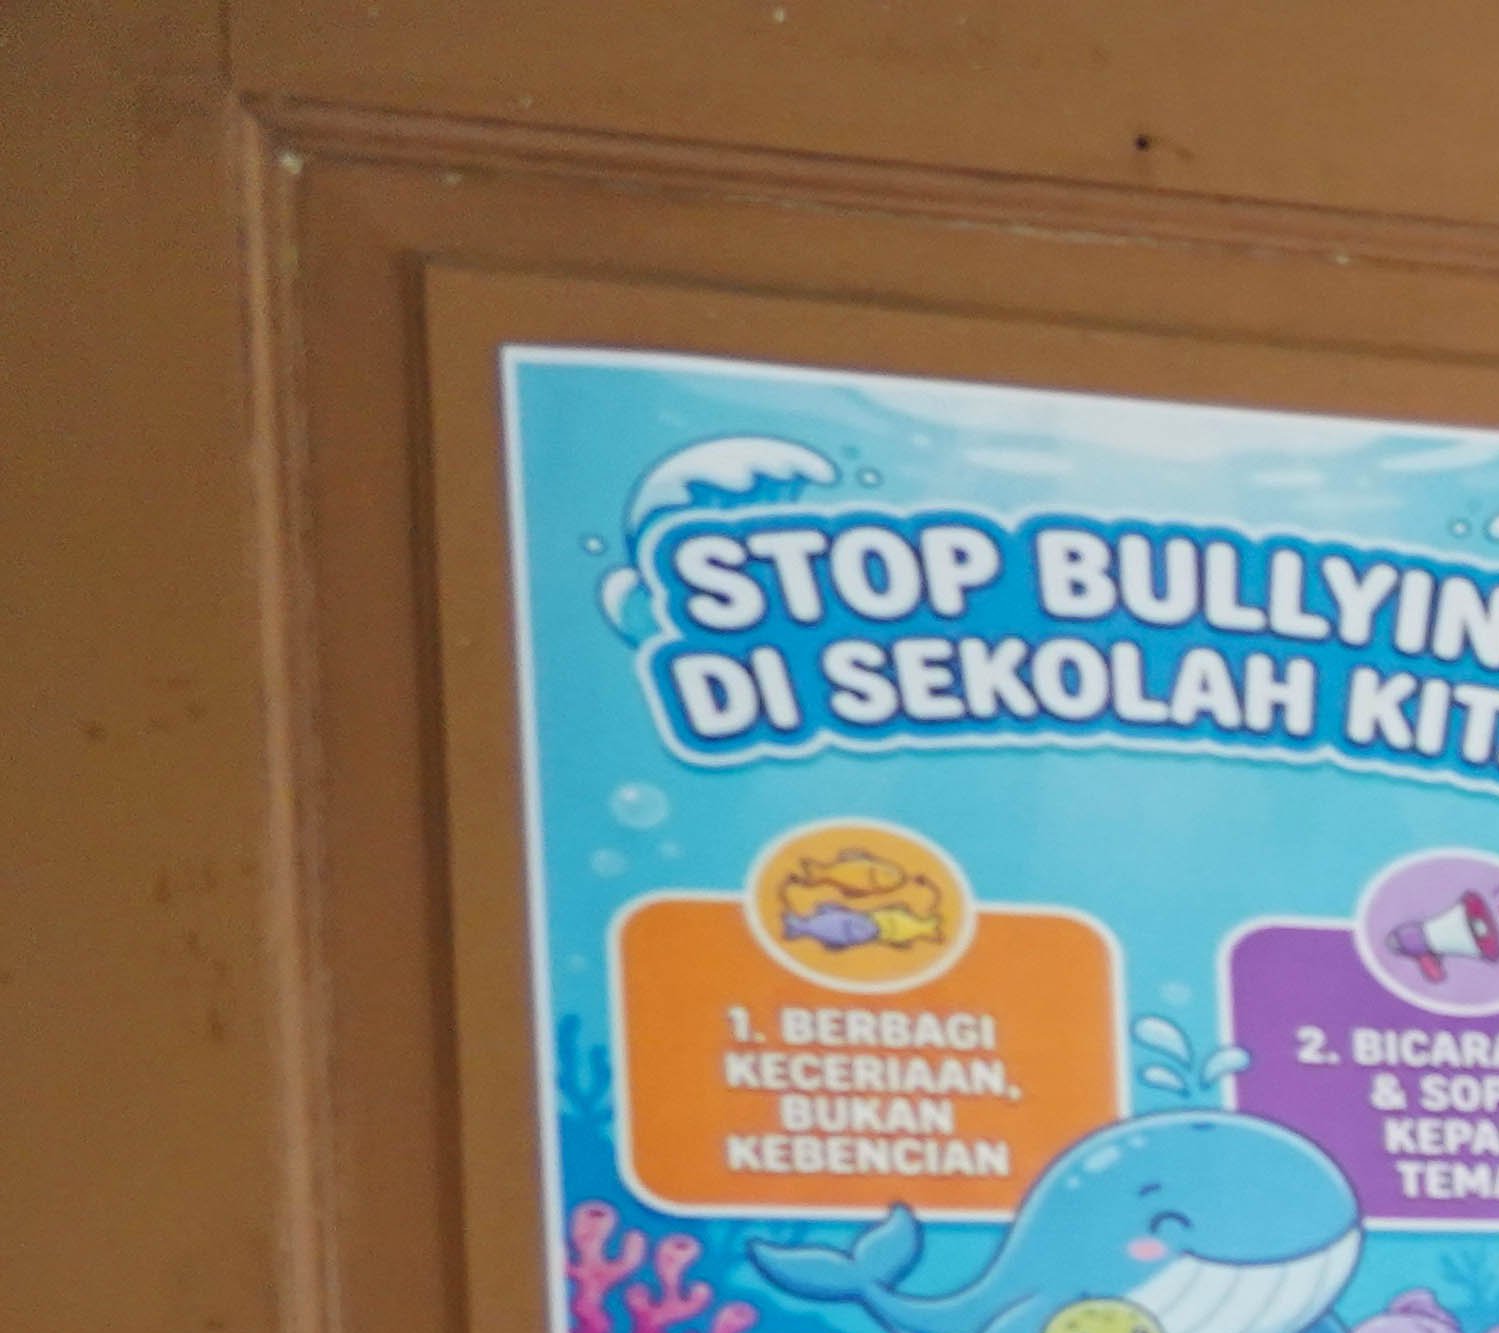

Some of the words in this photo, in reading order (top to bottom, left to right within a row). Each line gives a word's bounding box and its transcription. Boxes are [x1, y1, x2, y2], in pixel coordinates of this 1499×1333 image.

[675, 524, 999, 631] STOP
[673, 646, 799, 738] DI
[822, 637, 1314, 736] SEKOLAH
[727, 1006, 766, 1043] 1.
[780, 1007, 996, 1050] BERBAGI
[1296, 1025, 1340, 1065] 2.
[724, 1052, 1022, 1100] KECERIAAN,
[1369, 1073, 1407, 1110] &
[779, 1094, 955, 1135] BUKAN
[725, 1134, 1010, 1176] KEBENCIAN
